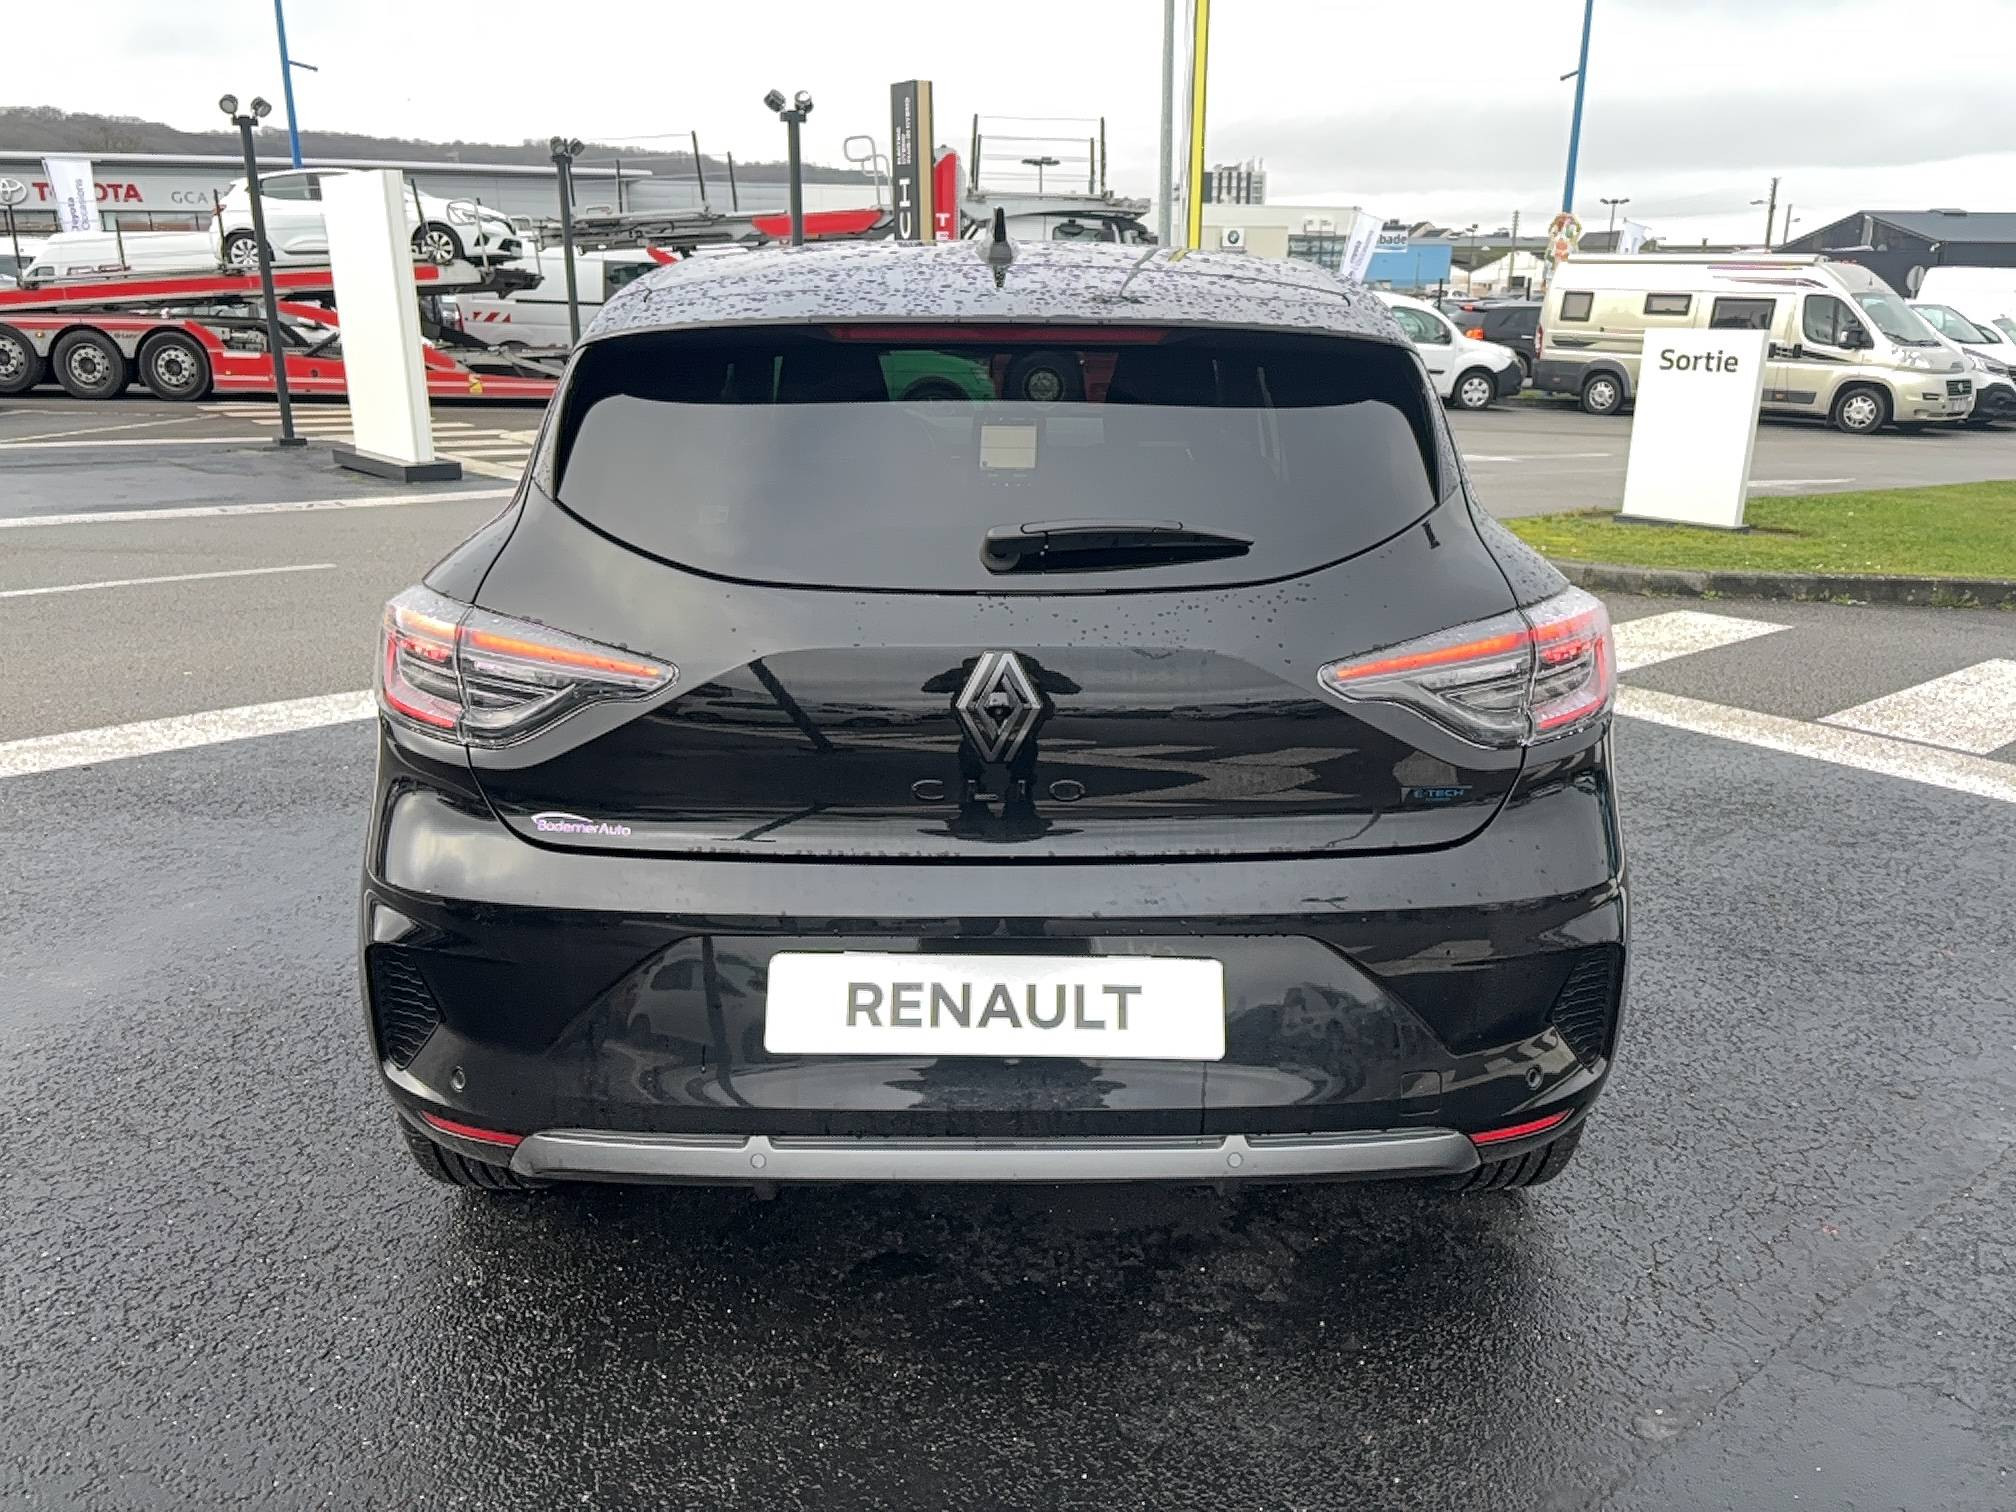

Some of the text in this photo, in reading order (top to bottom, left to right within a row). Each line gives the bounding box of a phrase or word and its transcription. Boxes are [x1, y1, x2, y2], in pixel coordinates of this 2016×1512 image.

[1659, 349, 1739, 373] Sortie
[911, 779, 1085, 801] CLIO
[846, 981, 1142, 1030] RENAULT
